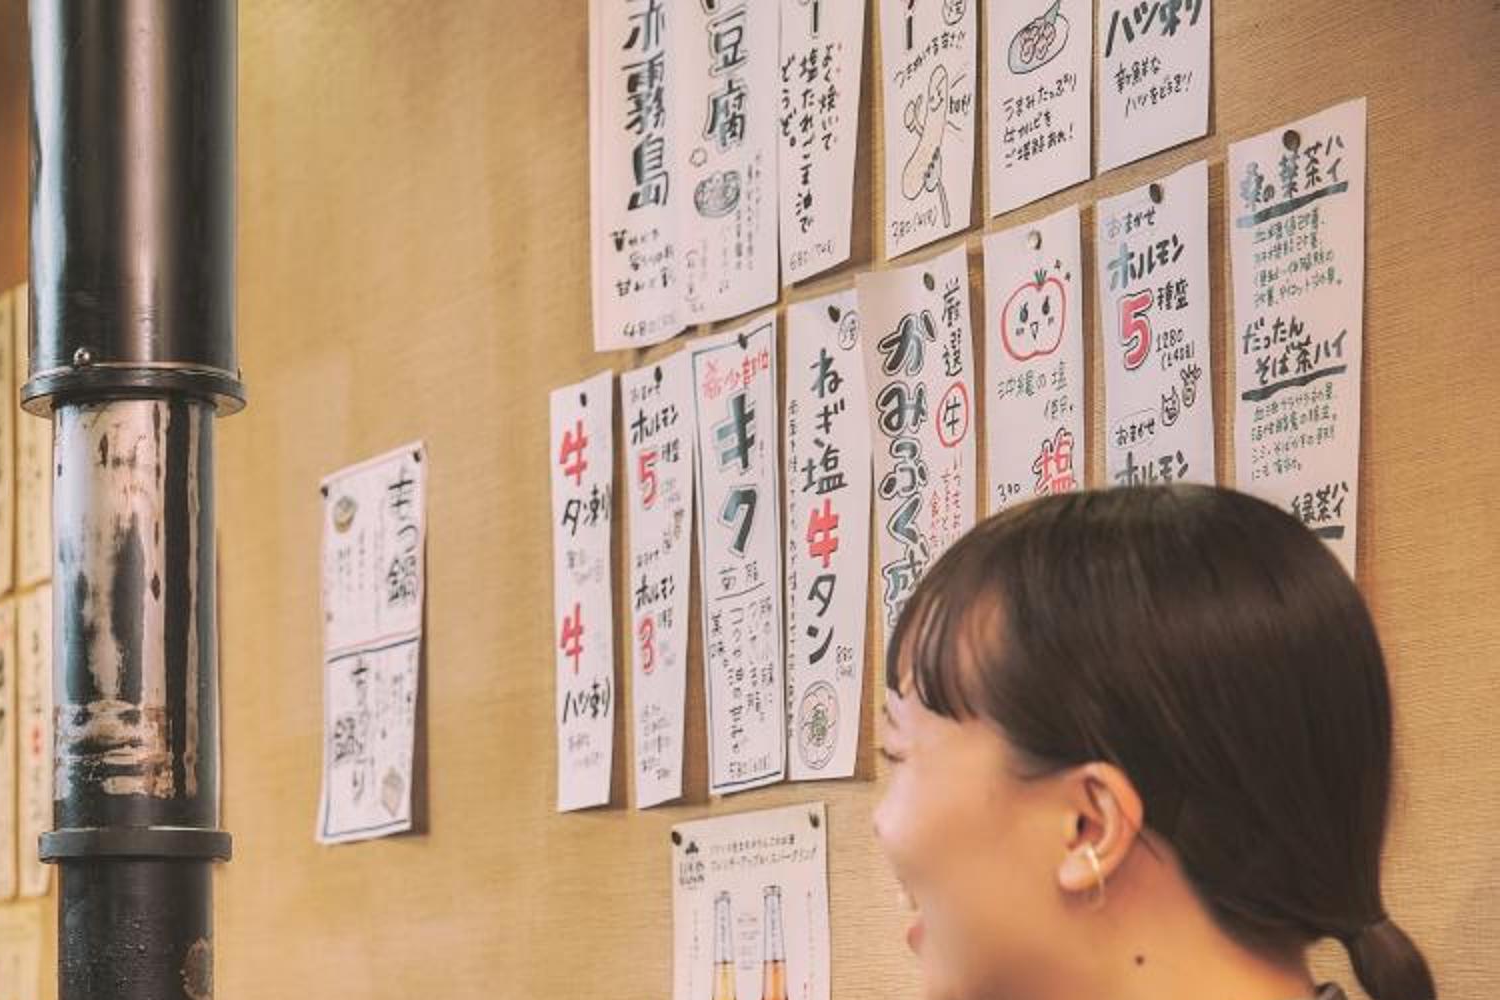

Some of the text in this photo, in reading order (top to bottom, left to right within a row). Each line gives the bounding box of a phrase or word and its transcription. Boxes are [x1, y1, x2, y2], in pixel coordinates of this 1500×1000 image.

[1108, 233, 1185, 291] ホルモン
[631, 404, 679, 446] ホルモン
